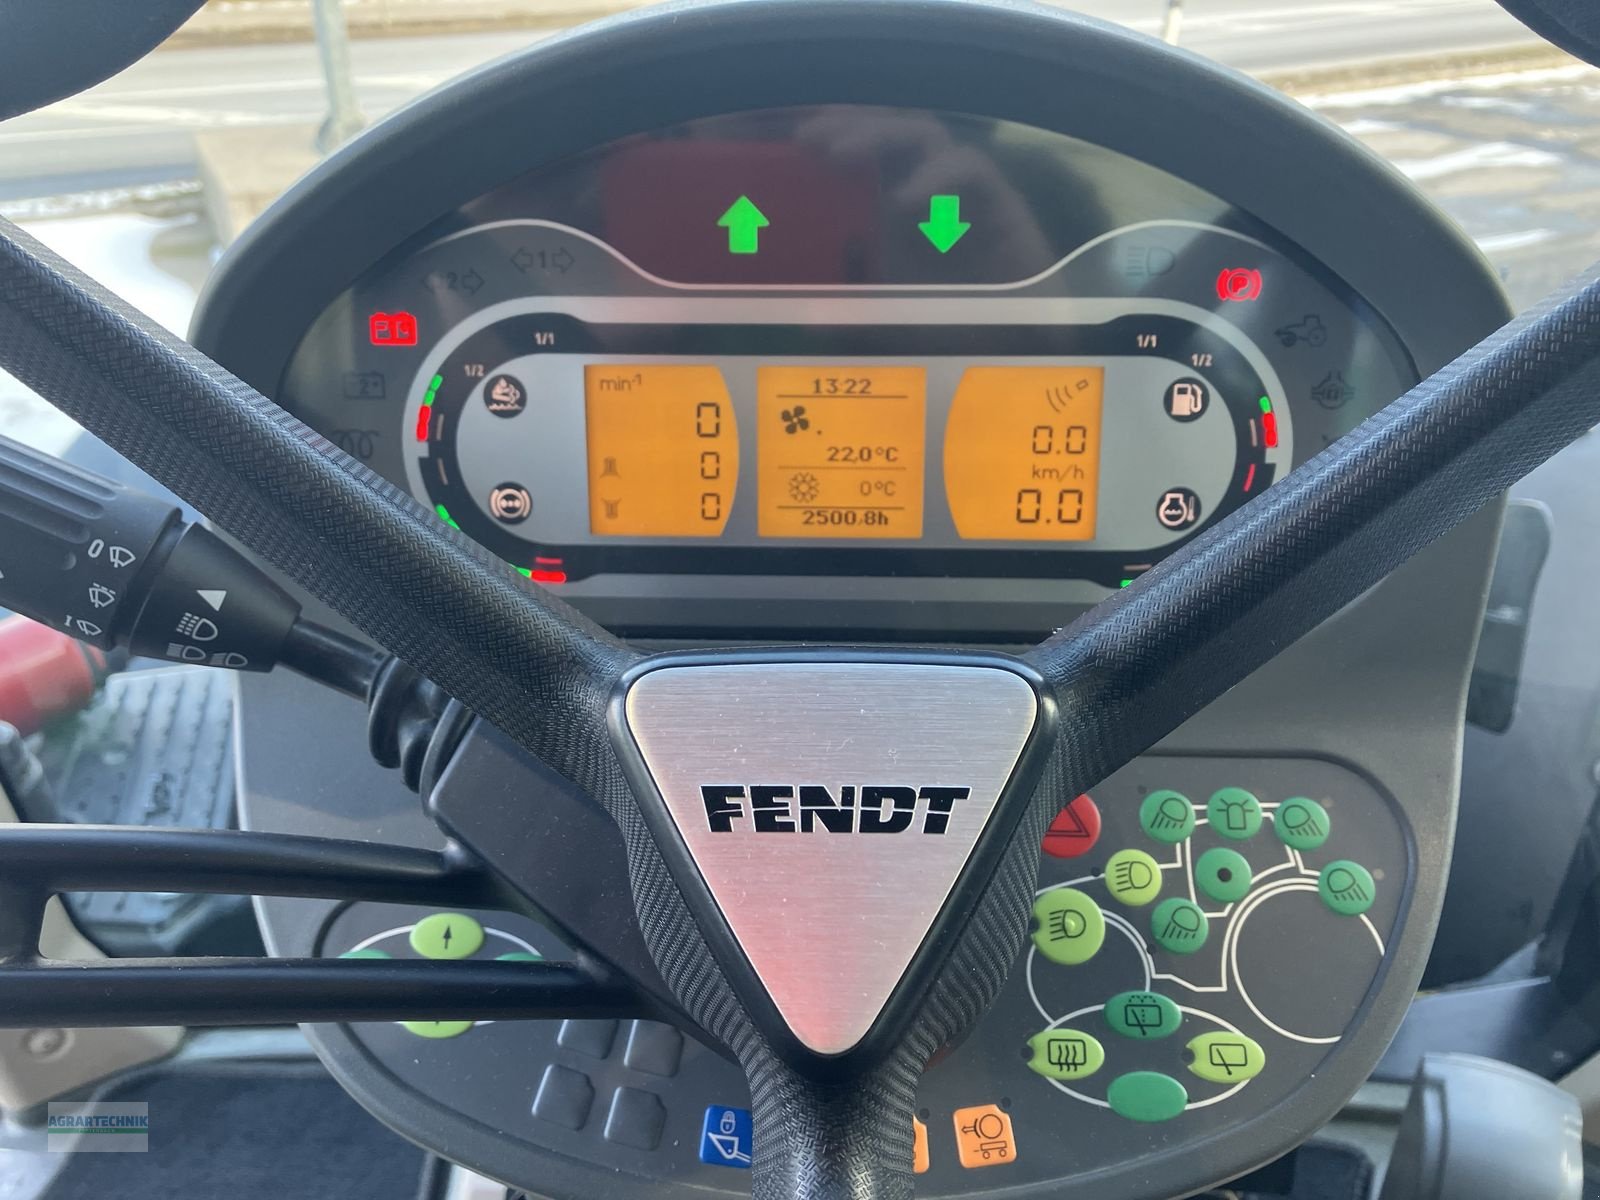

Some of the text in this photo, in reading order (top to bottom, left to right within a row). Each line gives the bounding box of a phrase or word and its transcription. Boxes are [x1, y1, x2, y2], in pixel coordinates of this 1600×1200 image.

[534, 332, 555, 345] 1/1
[1136, 334, 1157, 348] 1/1
[463, 363, 485, 377] 1/2
[1191, 354, 1212, 367] 1/2
[696, 402, 720, 437] 0
[1032, 425, 1087, 454] 0.0
[700, 451, 720, 479] 0
[1032, 464, 1084, 481] km/h
[701, 492, 720, 520] 0
[1016, 489, 1083, 523] 0.0
[87, 538, 104, 558] 0
[700, 785, 972, 834] FENDT
